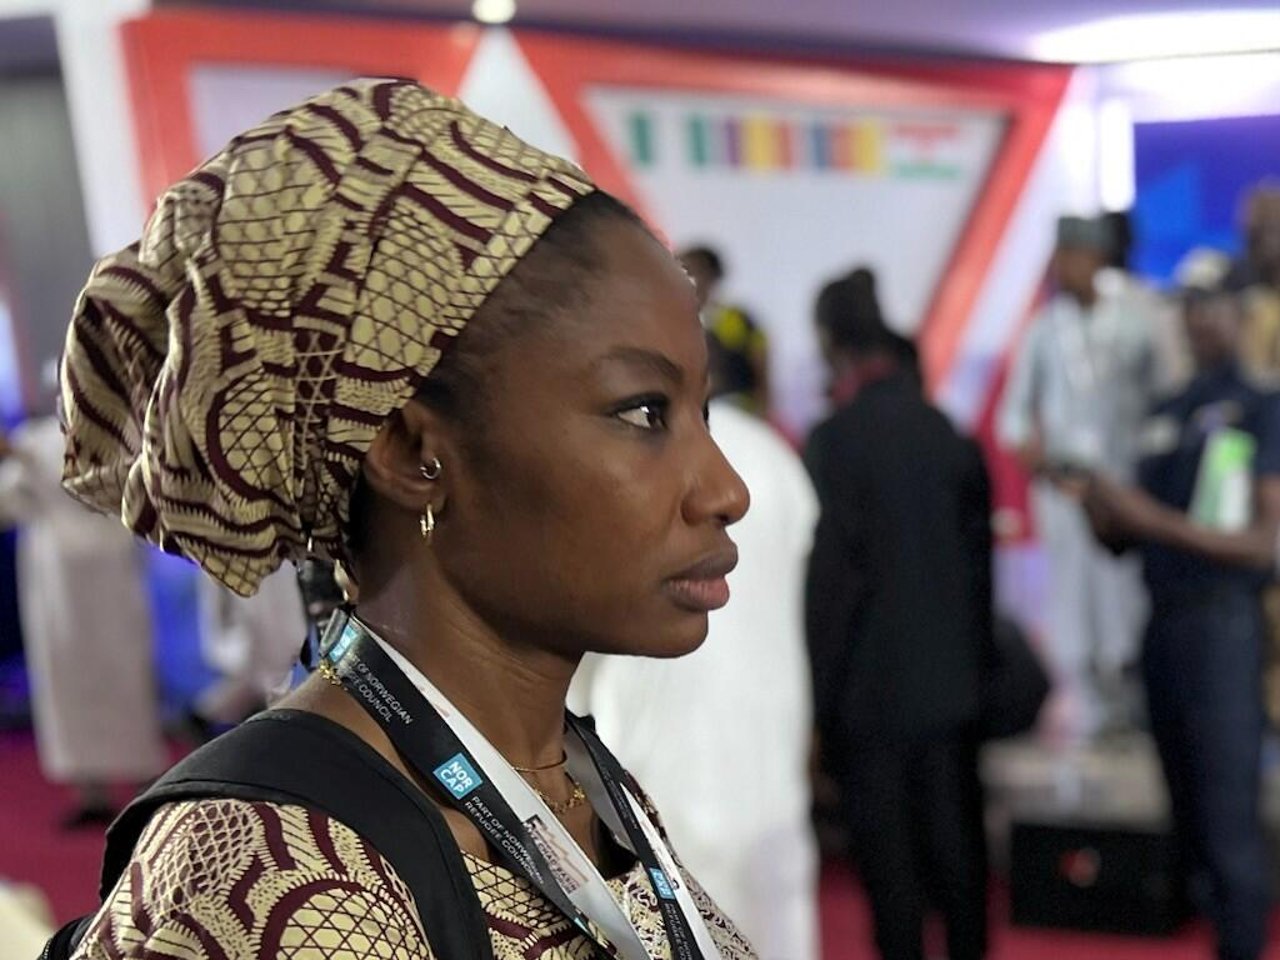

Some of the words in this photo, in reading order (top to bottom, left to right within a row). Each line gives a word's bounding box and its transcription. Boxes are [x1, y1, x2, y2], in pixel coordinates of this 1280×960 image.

[358, 684, 393, 722] COUNCIL
[366, 672, 413, 724] NORWEGIAN
[440, 769, 465, 793] CAP
[448, 761, 474, 789] NOR
[464, 801, 503, 839] REFUGEE
[471, 796, 492, 817] PART
[491, 817, 504, 831] OF
